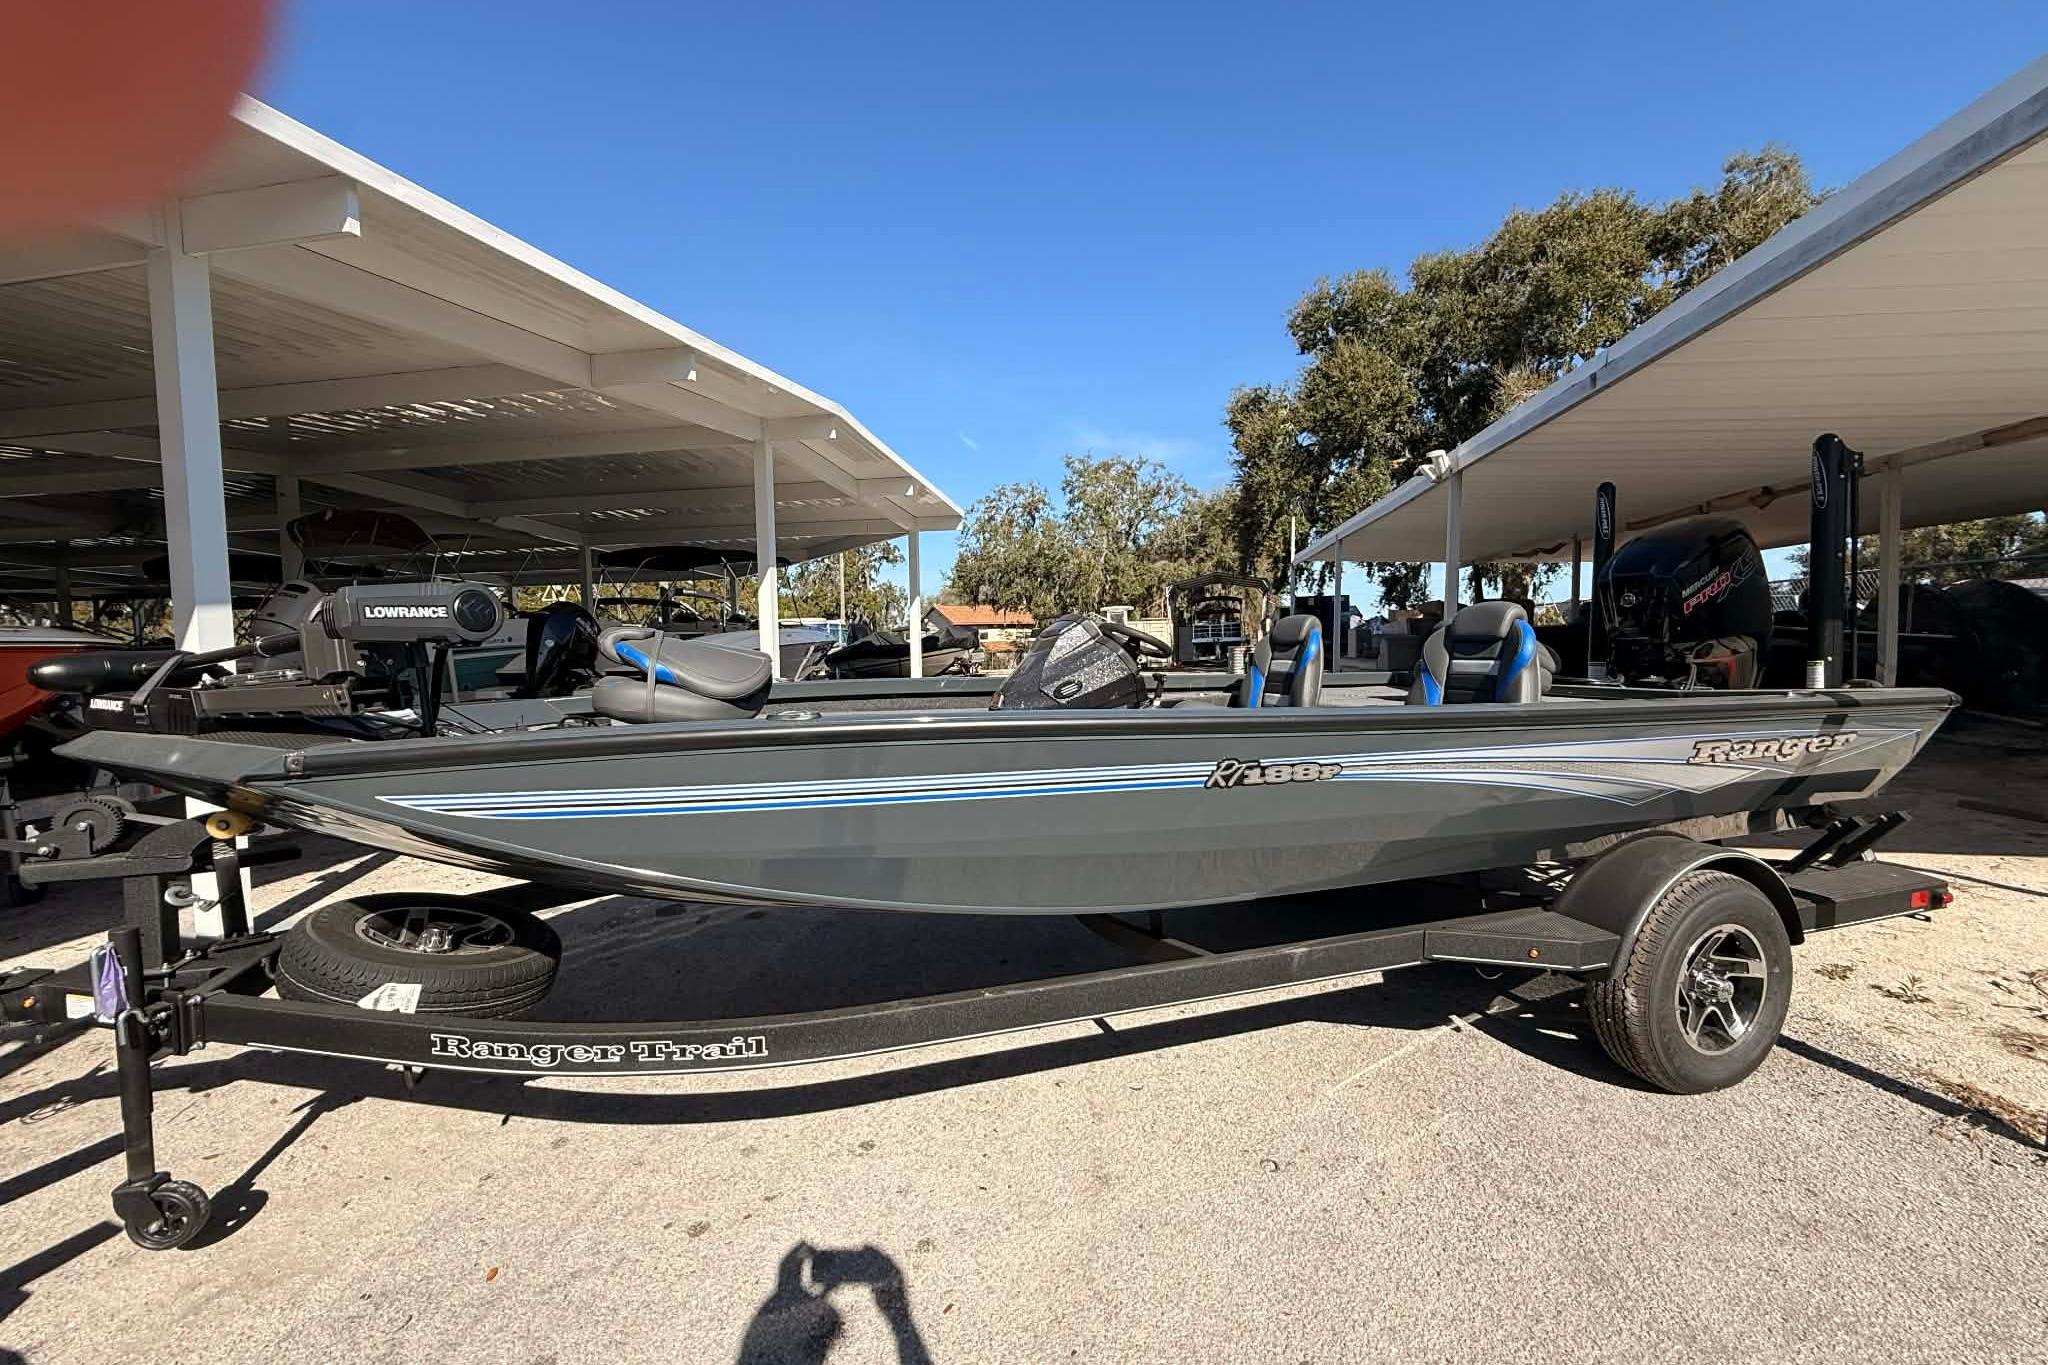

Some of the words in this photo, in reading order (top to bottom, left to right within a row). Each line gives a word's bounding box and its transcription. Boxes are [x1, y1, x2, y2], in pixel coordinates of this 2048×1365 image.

[1682, 565, 1720, 599] MERCURY
[364, 605, 449, 619] LOWRANCE
[1688, 731, 1858, 765] Ranger
[430, 1033, 626, 1067] Ranger
[630, 1036, 769, 1062] Trail
